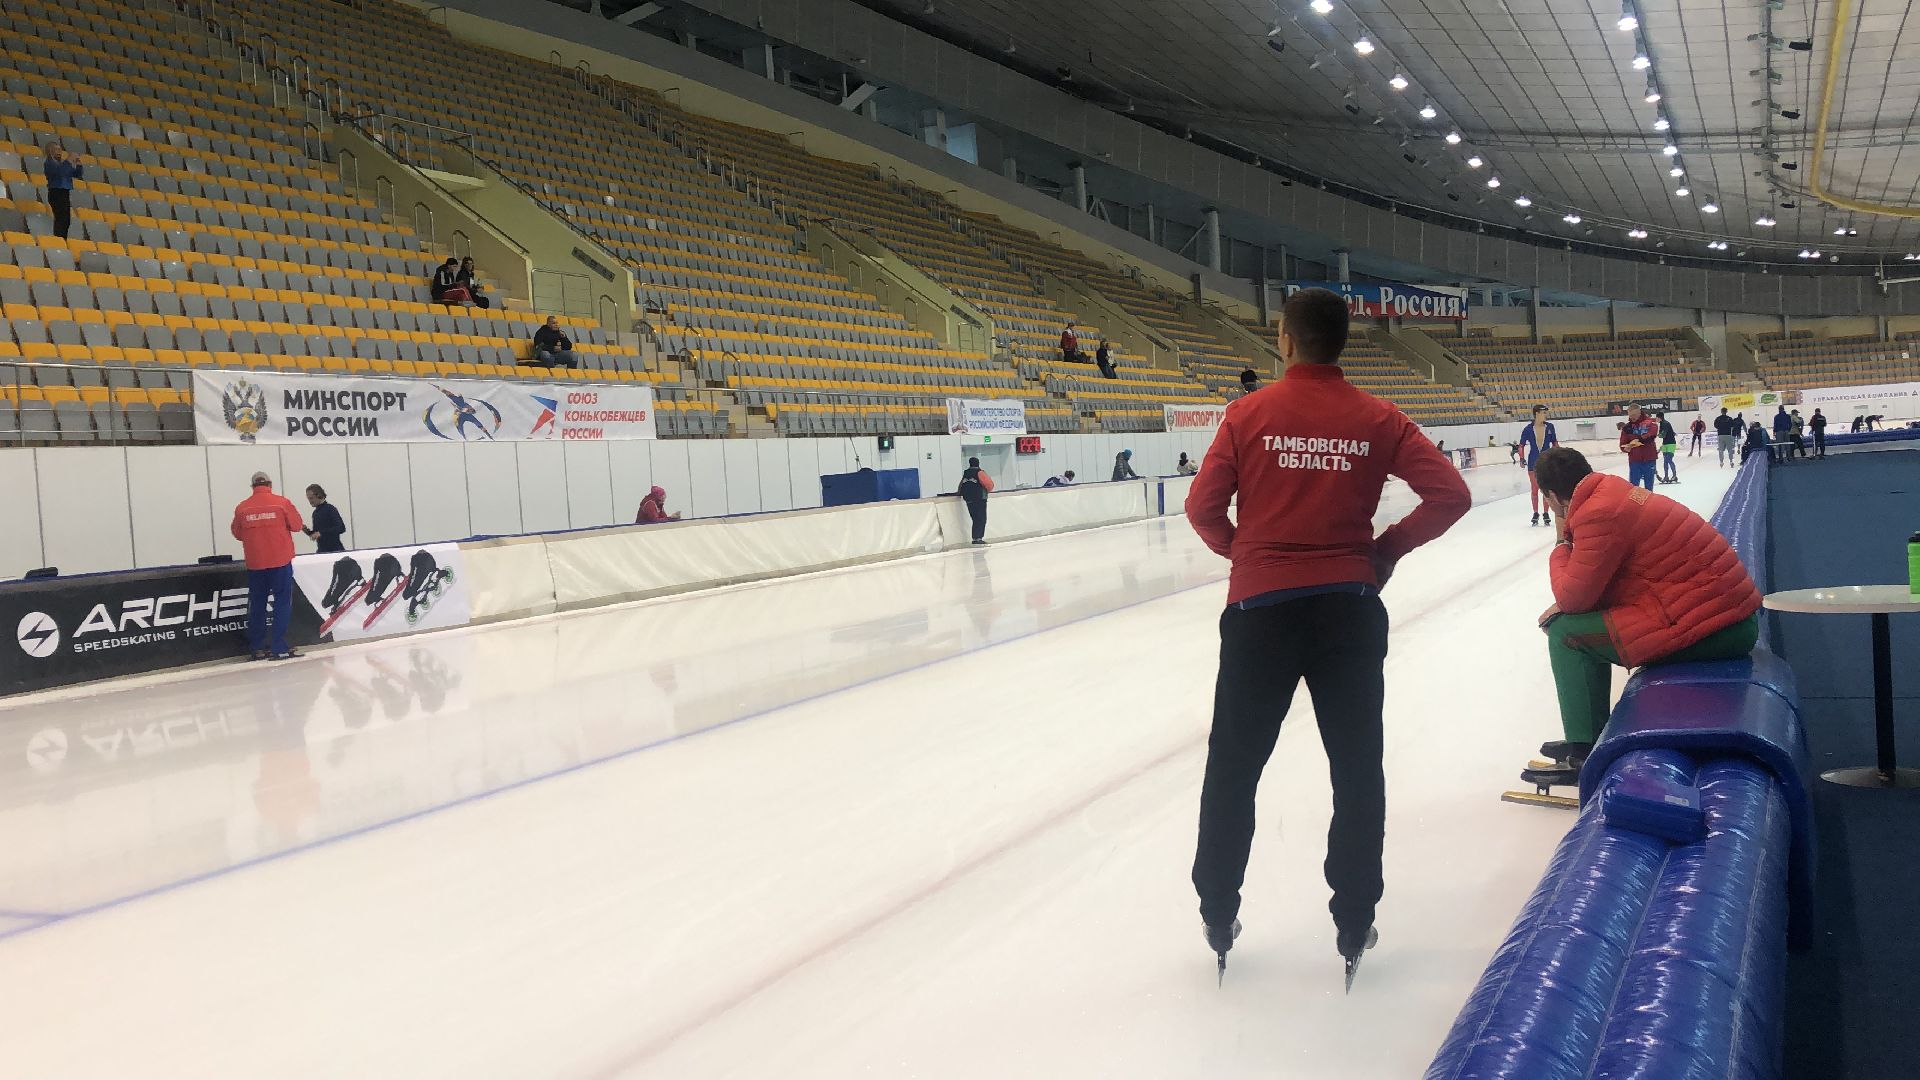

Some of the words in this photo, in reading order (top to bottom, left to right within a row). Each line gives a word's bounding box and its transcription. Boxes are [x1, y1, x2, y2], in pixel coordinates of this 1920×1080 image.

[1379, 286, 1467, 318] Россия!
[283, 389, 407, 412] МИНСПОРТ
[567, 392, 598, 405] СОЮЗ
[286, 416, 379, 437] РОССИИ
[564, 410, 646, 423] КОНЬКОБЕЖЦЕВ
[1173, 410, 1214, 427] МИНСПОРТ
[561, 428, 603, 440] РОССИИ
[1262, 435, 1370, 457] ТАМБОВСКАЯ
[1278, 452, 1352, 472] ОБЛАСТЬ
[72, 587, 275, 638] ARCHE
[74, 630, 176, 653] SPEEDSKATING
